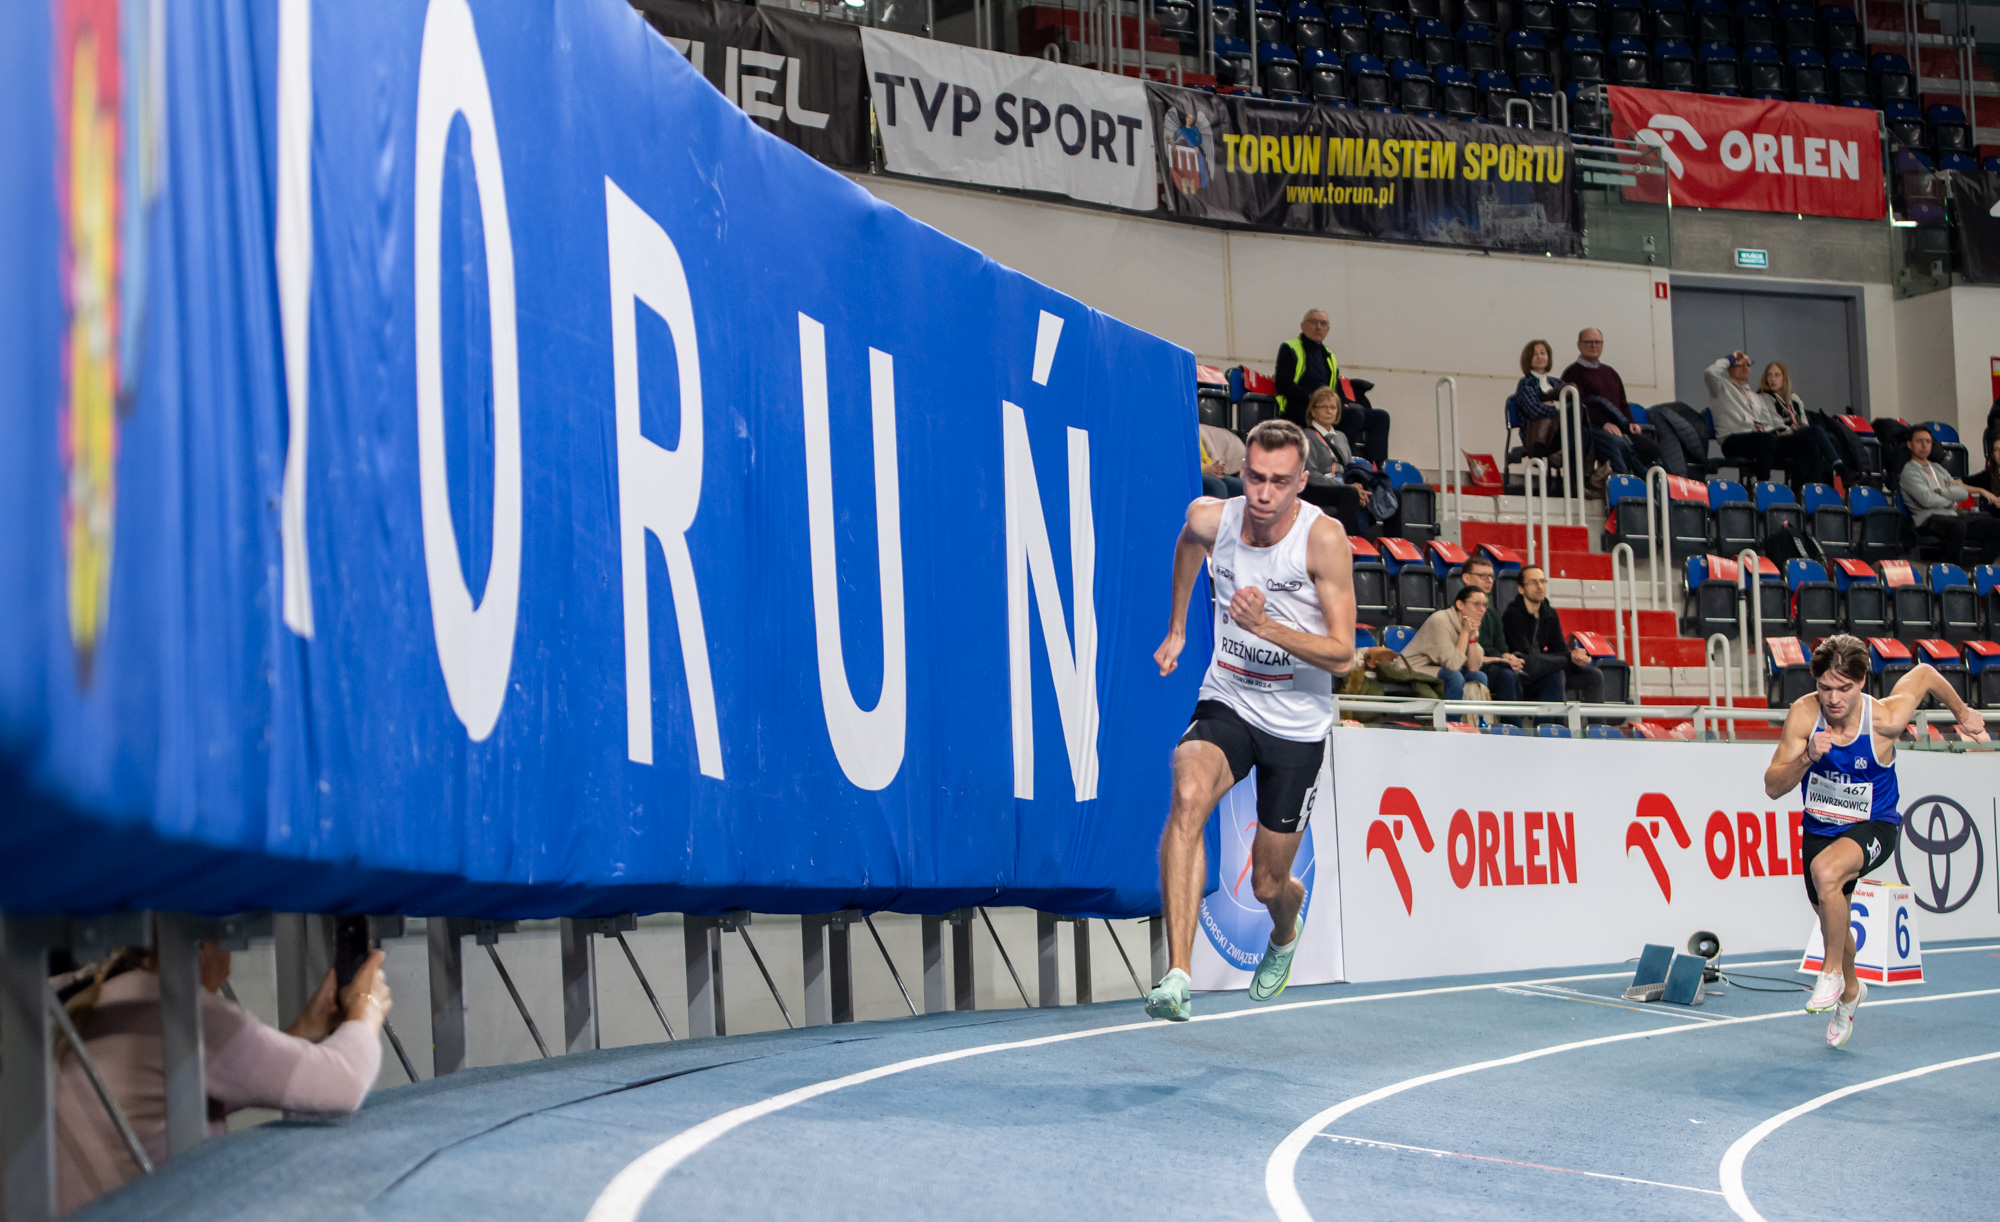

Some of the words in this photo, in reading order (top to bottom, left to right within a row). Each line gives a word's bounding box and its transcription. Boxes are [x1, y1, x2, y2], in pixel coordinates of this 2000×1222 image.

[874, 72, 981, 137] TVP
[994, 92, 1143, 167] SPORT
[1222, 124, 1321, 175] TORUŃ
[1327, 137, 1457, 180] MIASTEM
[1462, 142, 1564, 184] SPORTU
[1719, 130, 1860, 181] ORLEN
[1286, 182, 1395, 209] www.torun.pl
[1221, 636, 1291, 666] RZEŹNICZAK
[1254, 680, 1272, 688] 2024
[1306, 787, 1317, 812] 6
[1809, 791, 1869, 813] WAWRZKOWICZ
[1843, 786, 1867, 796] 467
[1447, 808, 1578, 889] ORLEN
[1705, 810, 1804, 880] ORLE
[1852, 888, 1875, 899] olanik
[1199, 897, 1229, 950] OMORSKI
[1226, 942, 1260, 966] ZWIĄZEK
[1895, 906, 1910, 959] 6
